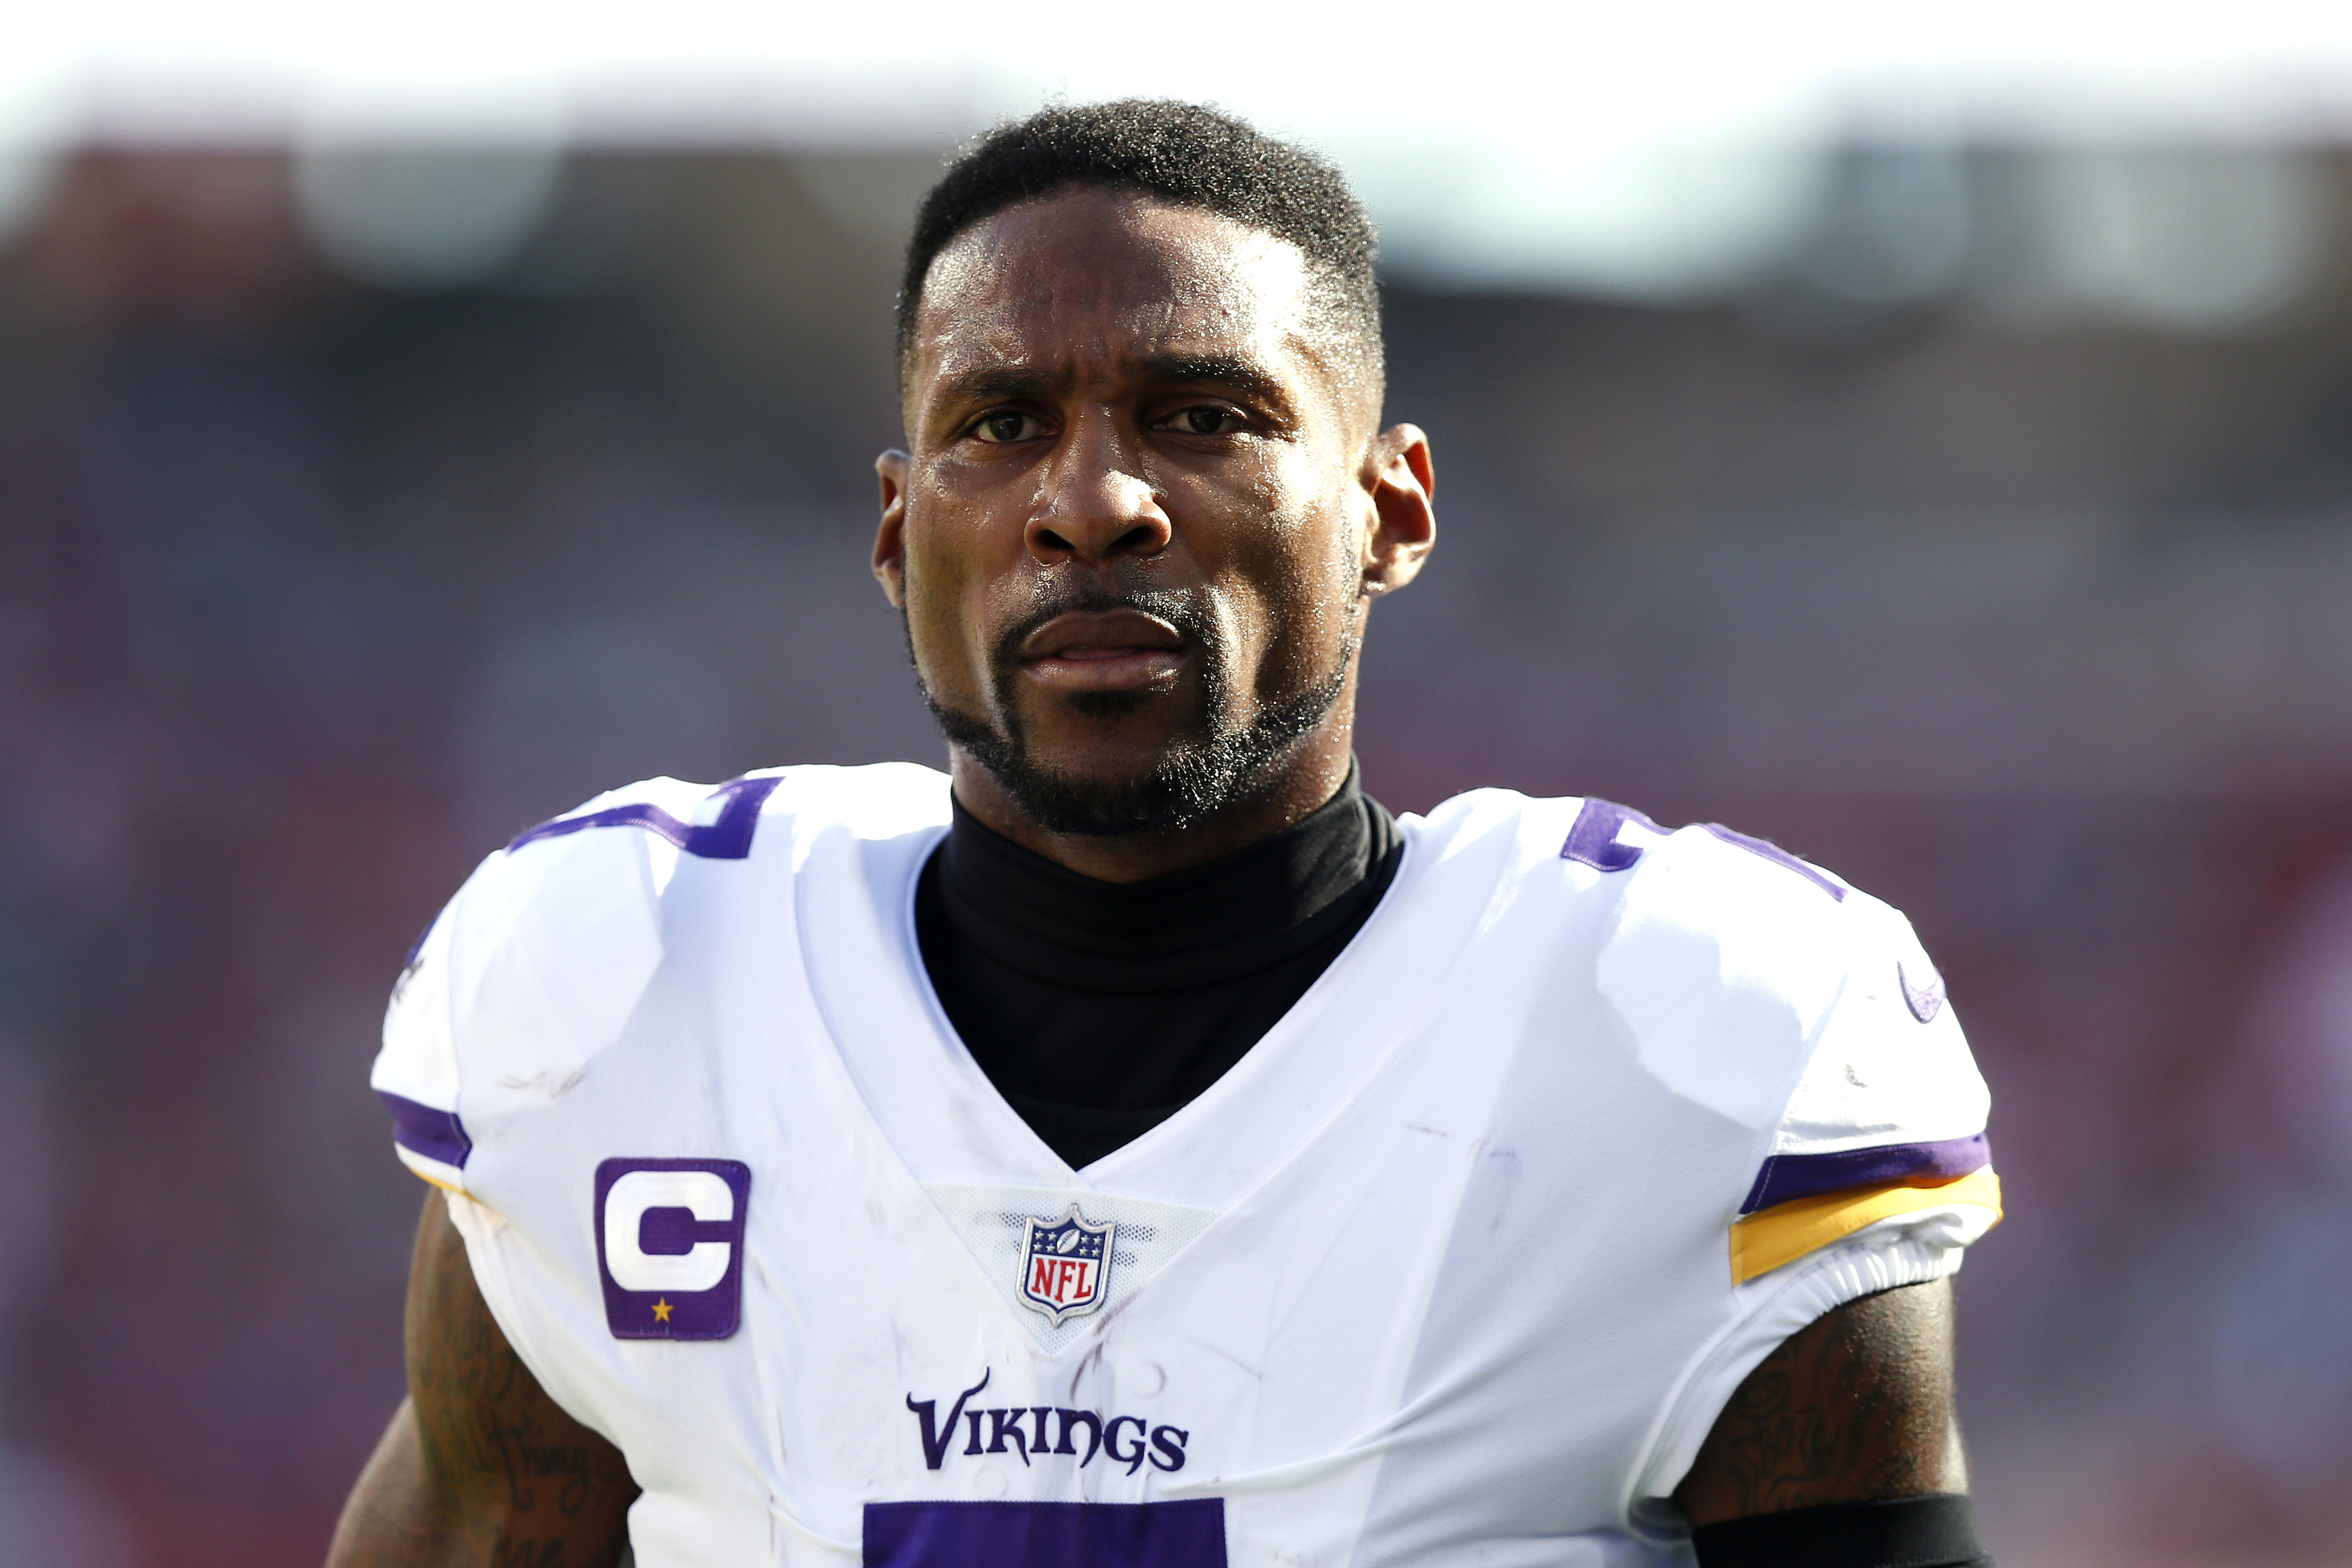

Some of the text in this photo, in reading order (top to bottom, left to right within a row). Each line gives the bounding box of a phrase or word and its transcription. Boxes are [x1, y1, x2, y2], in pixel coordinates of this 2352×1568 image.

[604, 1171, 734, 1293] C
[1031, 1258, 1091, 1303] NFL
[906, 1366, 1189, 1476] VIKINGS
